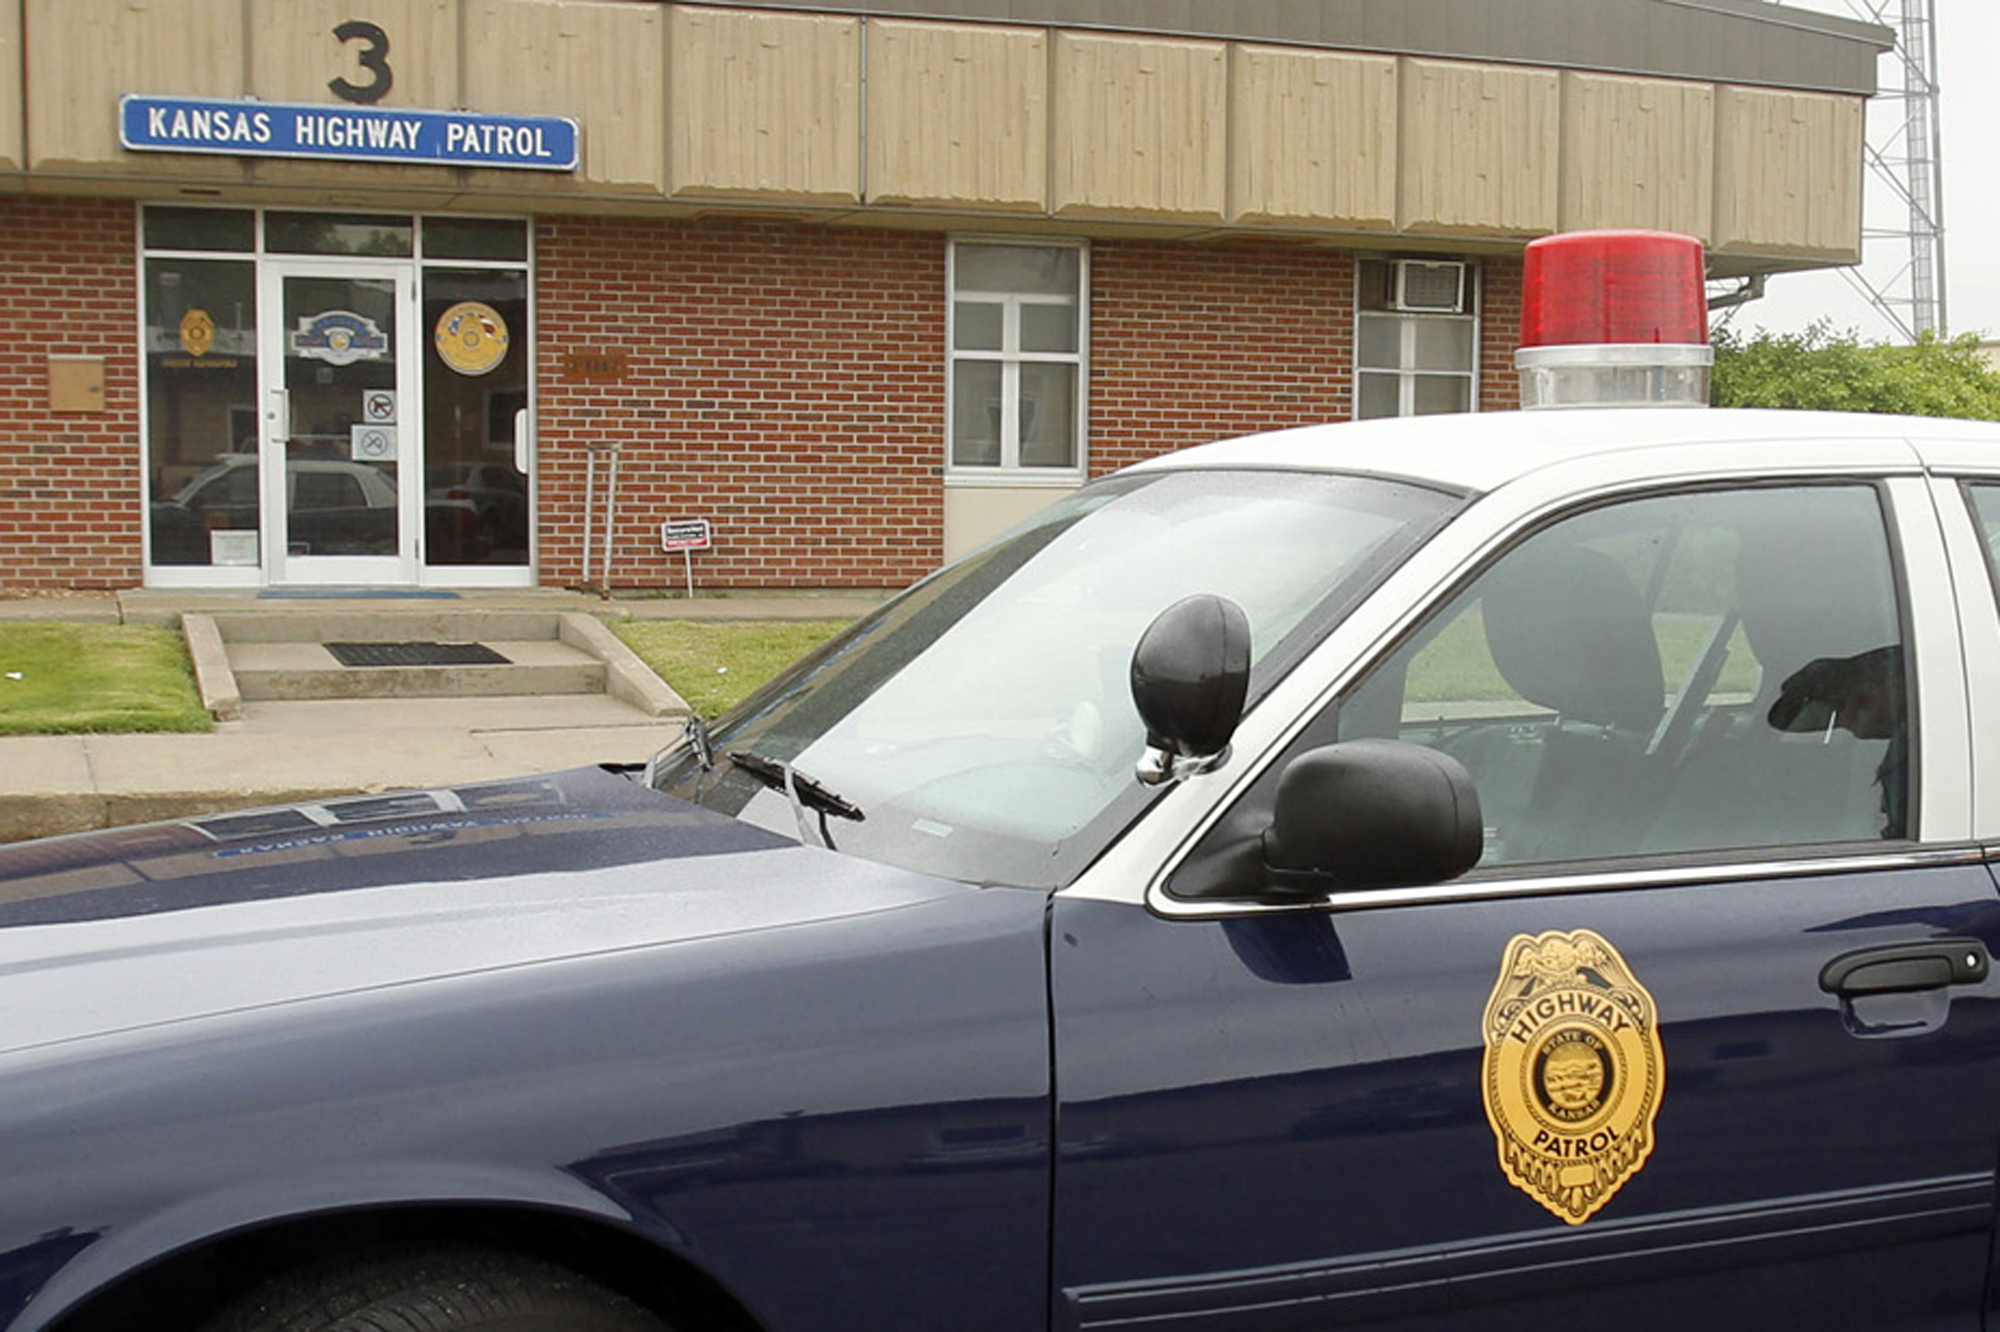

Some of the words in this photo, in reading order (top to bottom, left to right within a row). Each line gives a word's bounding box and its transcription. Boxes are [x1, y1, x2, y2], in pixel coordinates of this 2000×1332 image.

[327, 21, 393, 104] 3
[148, 107, 272, 143] KANSAS
[296, 115, 422, 150] HIGHWAY
[446, 123, 551, 157] PATROL
[1511, 992, 1630, 1044] HIGHWAY
[1542, 1031, 1581, 1055] STATE
[1584, 1034, 1603, 1050] OF
[1548, 1101, 1601, 1120] KANSAS
[1533, 1126, 1620, 1157] PATROL
